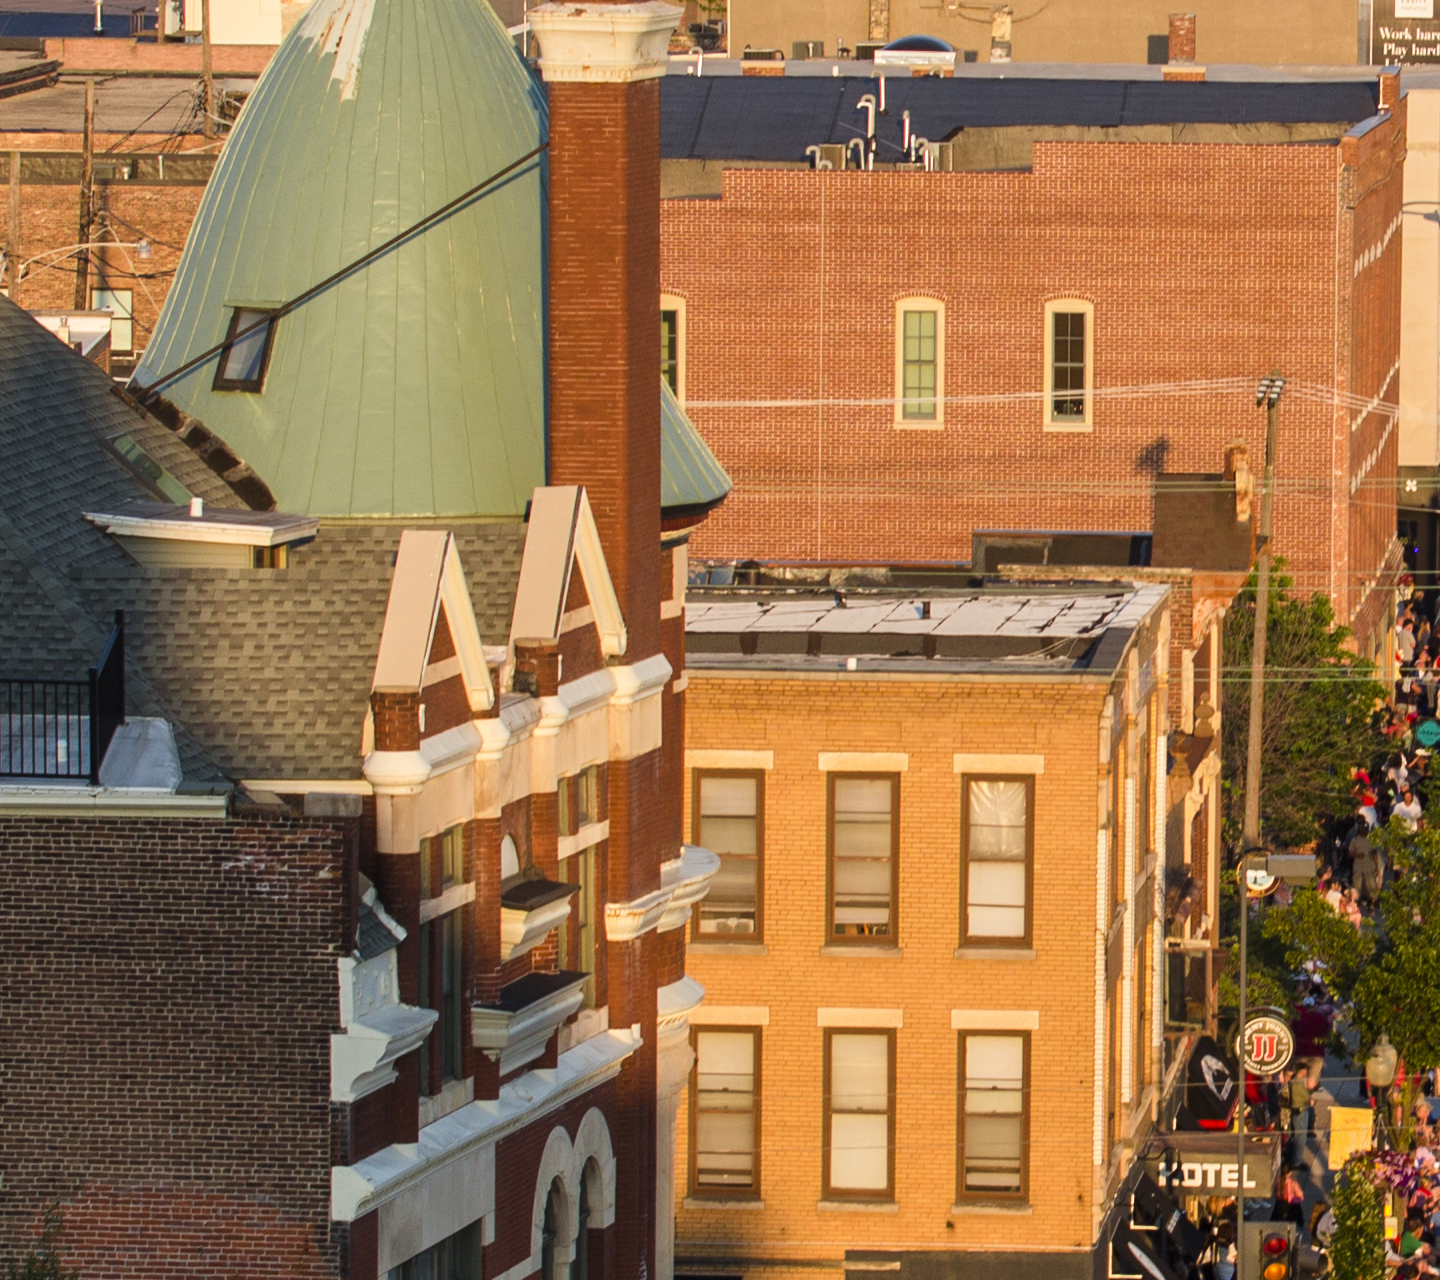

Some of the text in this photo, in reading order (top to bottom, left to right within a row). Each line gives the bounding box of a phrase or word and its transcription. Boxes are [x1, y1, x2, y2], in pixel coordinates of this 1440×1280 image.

[1379, 27, 1412, 40] Work
[1383, 42, 1408, 59] Play
[1252, 1034, 1278, 1061] JJ
[1158, 1162, 1257, 1188] HOTEL
